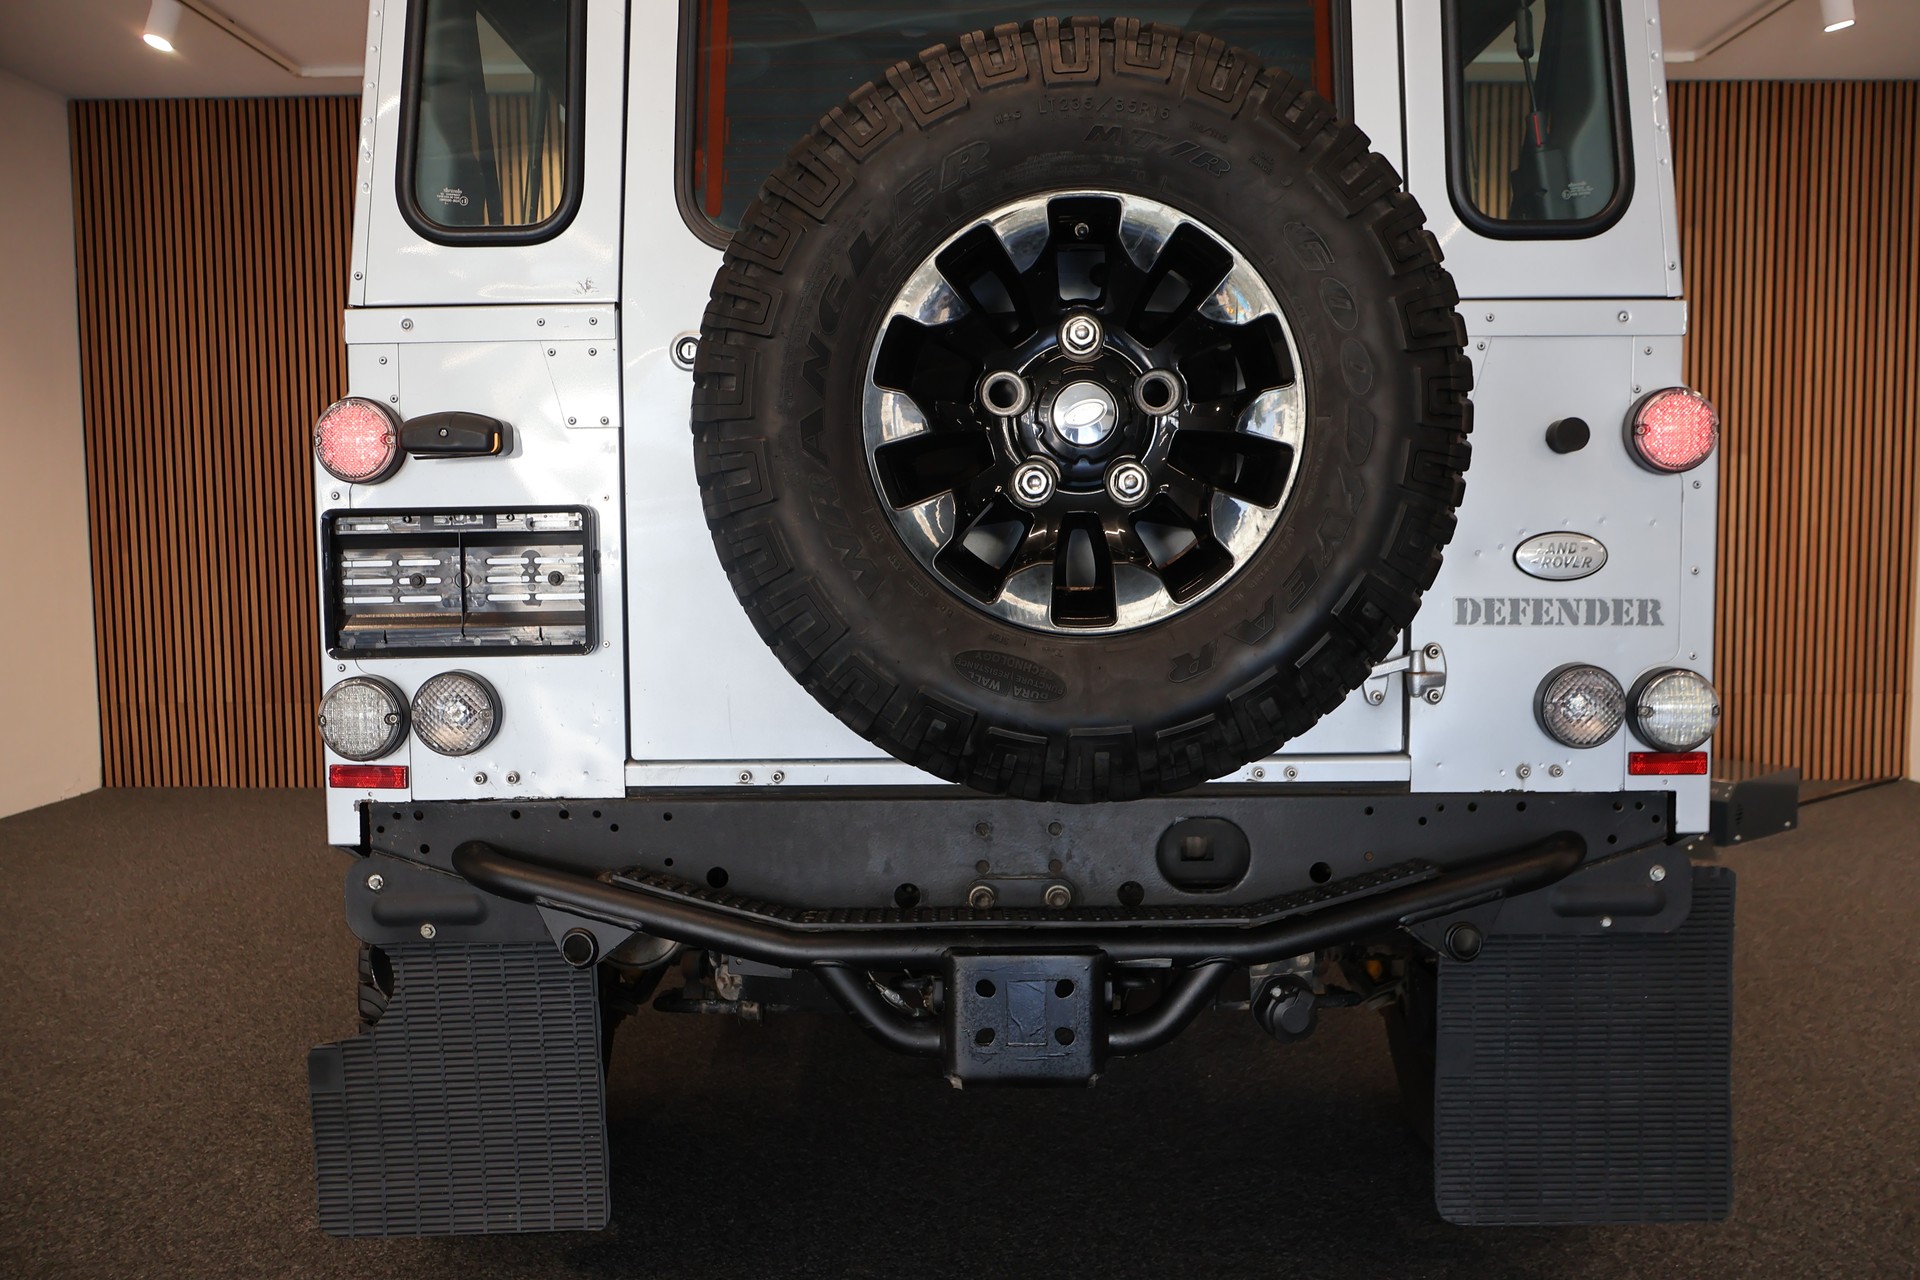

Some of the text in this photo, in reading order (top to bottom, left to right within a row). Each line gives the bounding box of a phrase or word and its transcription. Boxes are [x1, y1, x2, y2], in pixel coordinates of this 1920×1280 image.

[799, 140, 990, 600] WRANGLER
[1082, 123, 1232, 177] MT/R
[1168, 221, 1375, 684] GOODYEAR
[1539, 555, 1593, 569] ROVER
[1454, 597, 1665, 627] DEFENDER
[955, 657, 1064, 695] PUNCTURE RESISTANCE
[968, 671, 1049, 700] DURA WALL
